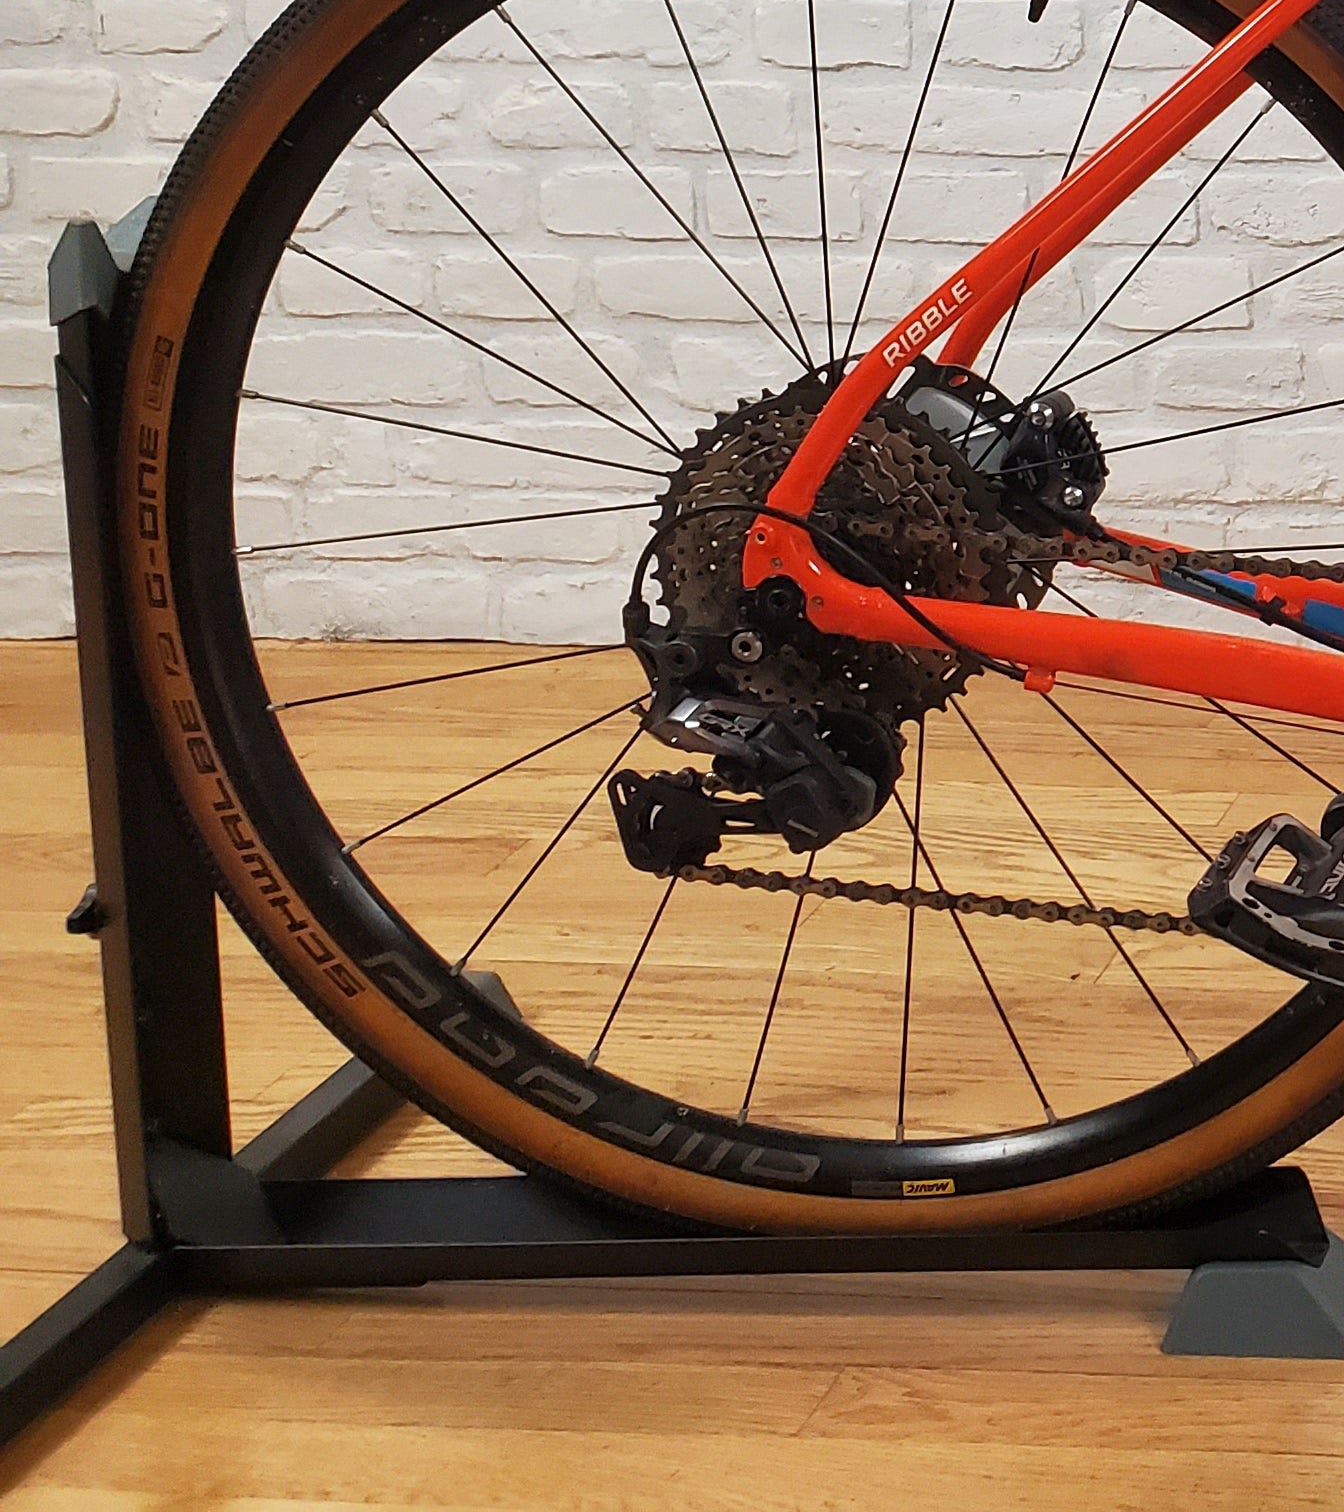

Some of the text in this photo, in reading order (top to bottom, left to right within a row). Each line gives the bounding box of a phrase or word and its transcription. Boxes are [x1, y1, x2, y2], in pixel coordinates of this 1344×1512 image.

[881, 278, 974, 370] RIBBLE
[137, 427, 171, 610] G-ONE
[172, 698, 367, 999] SCHWALBE
[905, 1180, 951, 1194] MAVIC
